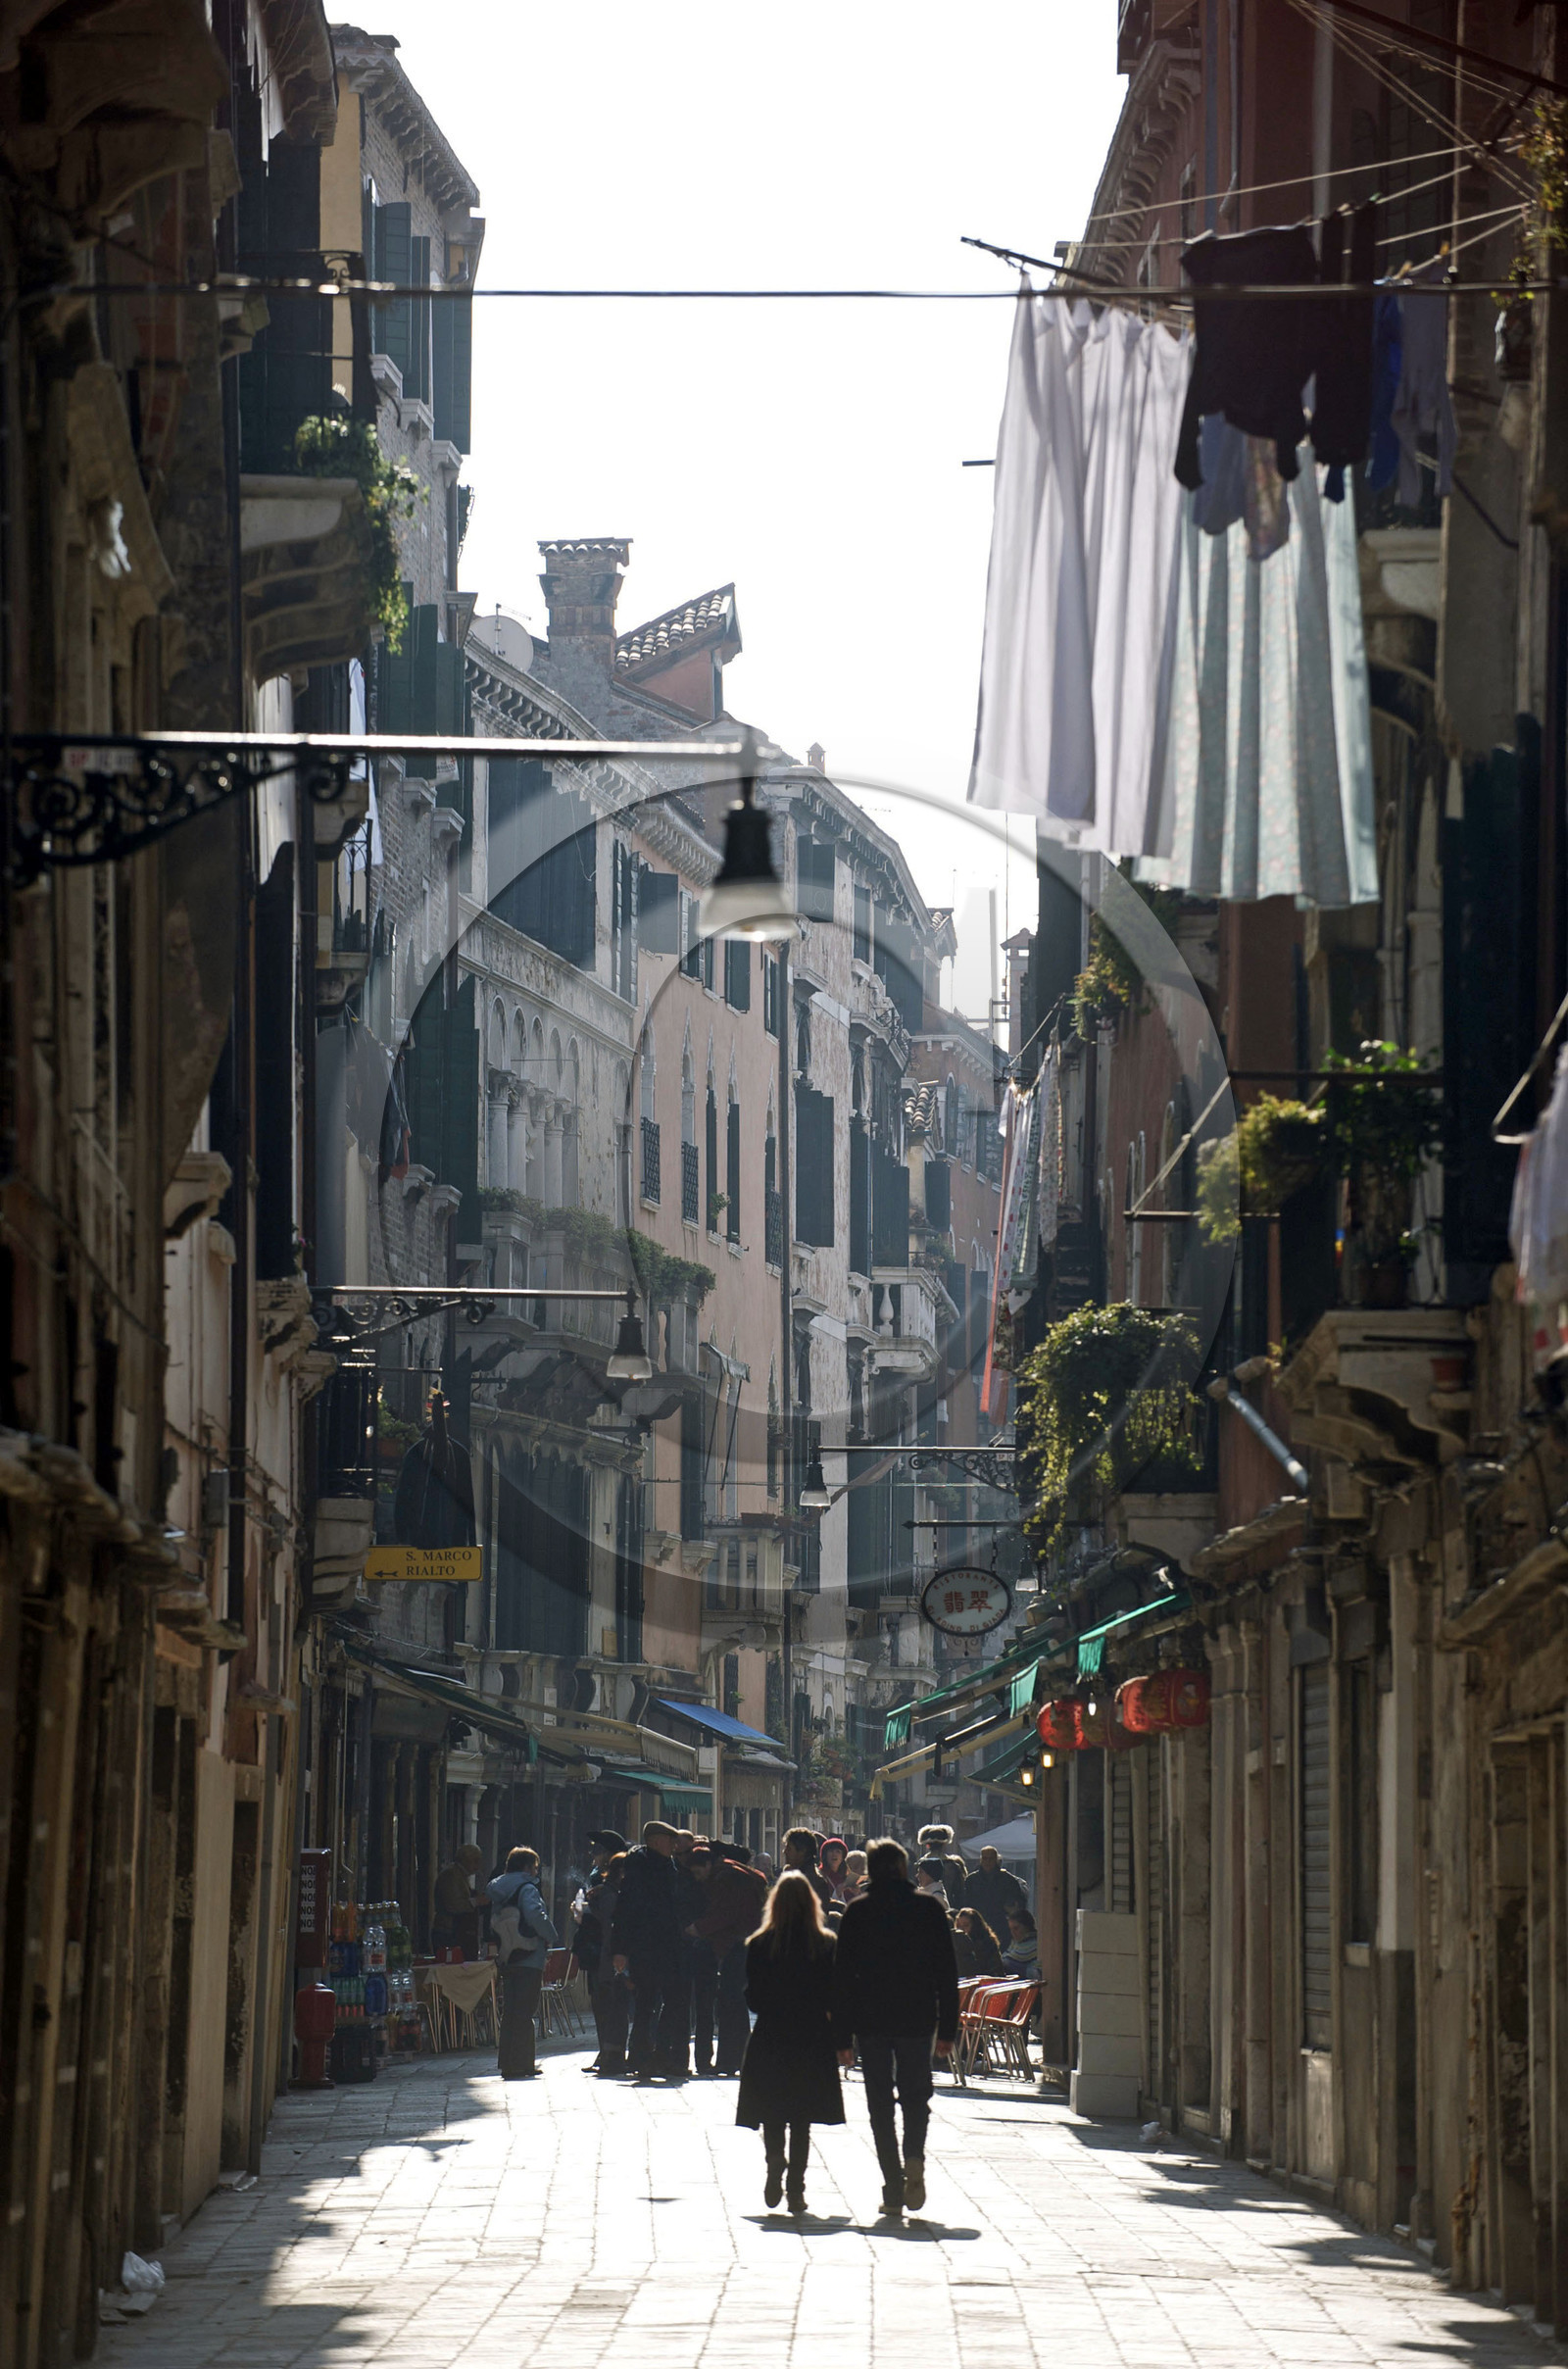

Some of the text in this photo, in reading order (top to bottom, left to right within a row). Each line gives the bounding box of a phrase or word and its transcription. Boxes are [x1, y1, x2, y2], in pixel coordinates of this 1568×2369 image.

[406, 1551, 472, 1561] S. MARCO
[406, 1565, 456, 1576] RIALTO
[933, 1572, 1000, 1590] RISTORANTE
[944, 1590, 994, 1613] 翡翠
